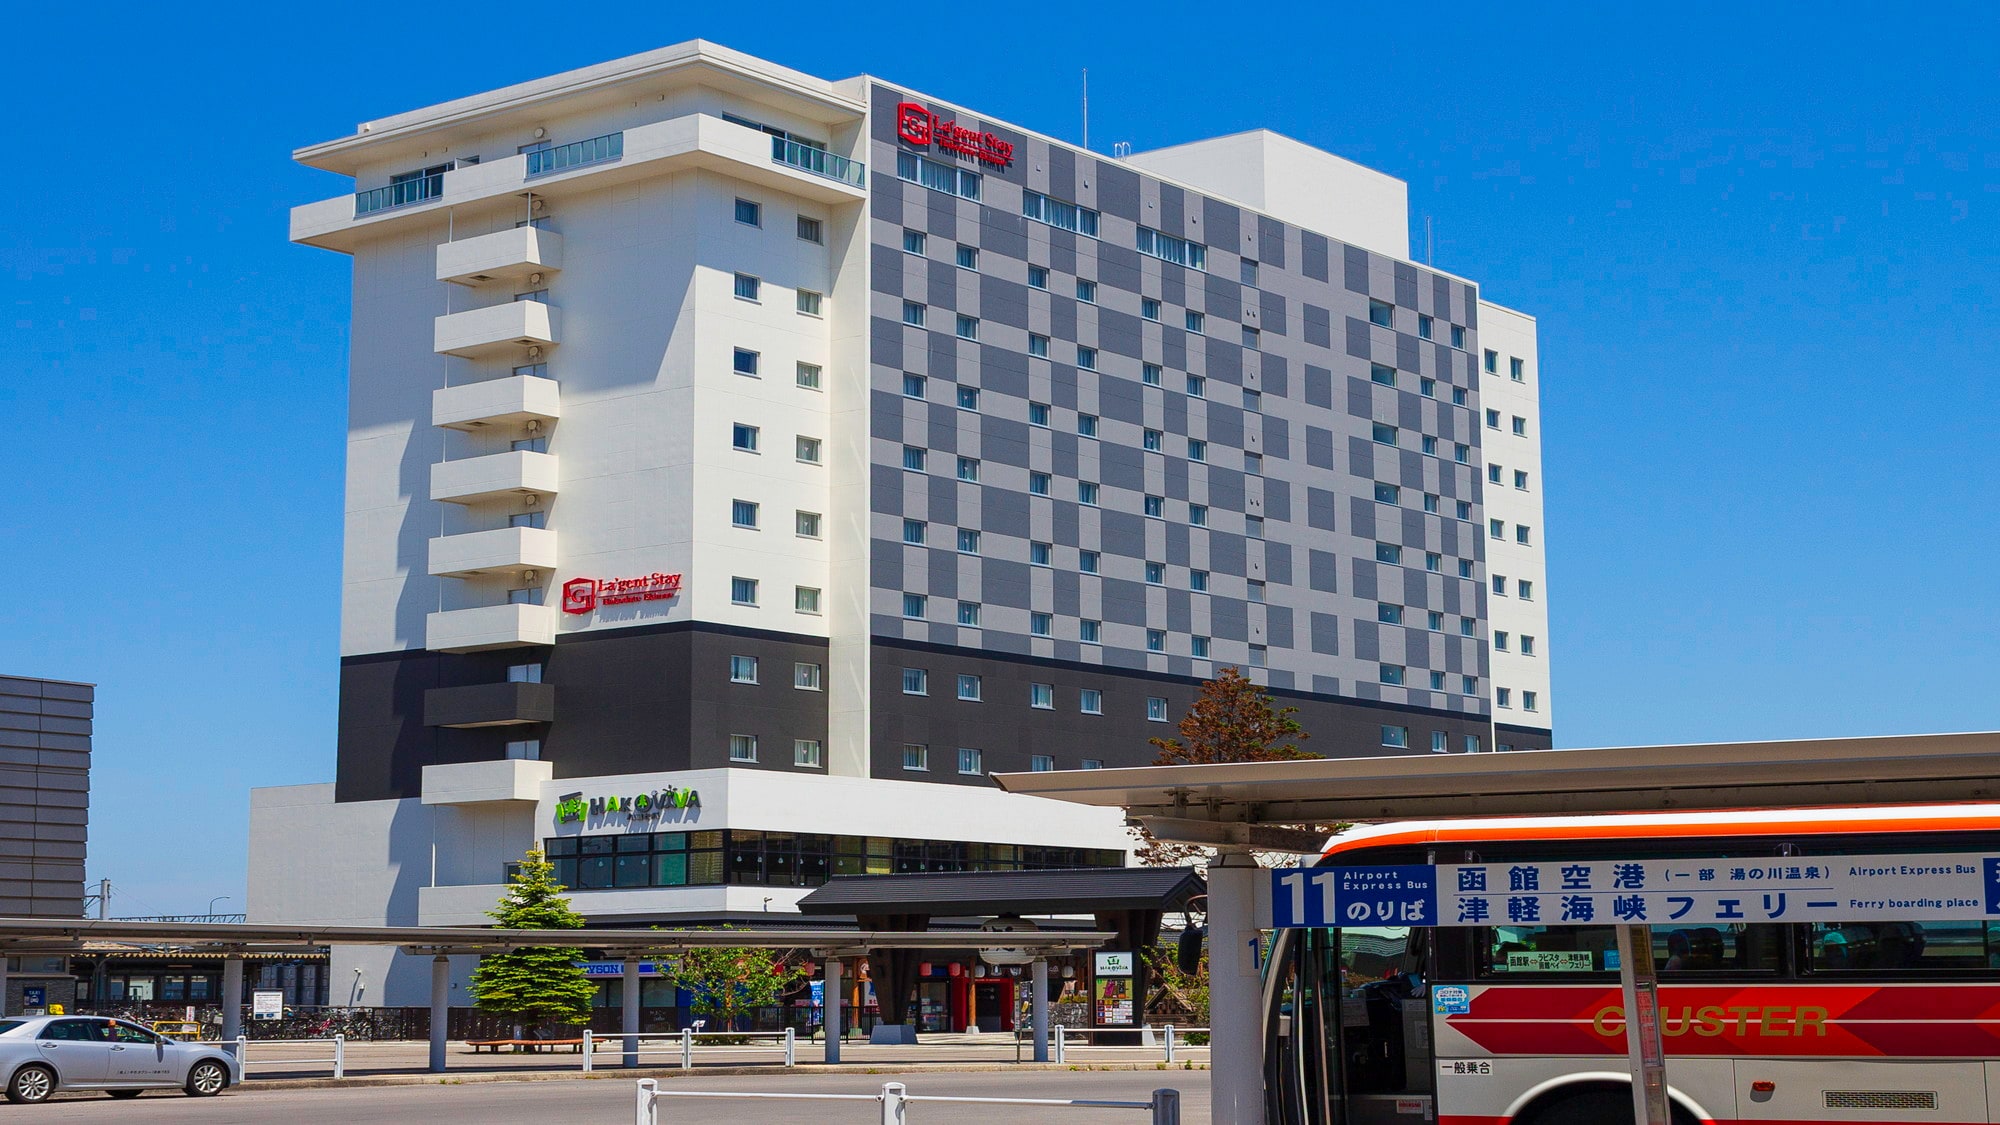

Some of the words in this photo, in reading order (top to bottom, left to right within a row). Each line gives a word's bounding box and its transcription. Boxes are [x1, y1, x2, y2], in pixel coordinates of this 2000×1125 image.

[934, 115, 983, 144] La'gent
[985, 132, 1014, 157] Stay
[598, 575, 649, 592] La'gent
[651, 572, 682, 588] Stay
[1343, 871, 1398, 881] Airport
[1849, 866, 1897, 877] Airport
[1900, 865, 1952, 876] Express
[1955, 864, 1976, 874] Bus
[1457, 864, 1646, 892] 函館空港
[1343, 881, 1402, 891] Express
[1407, 880, 1428, 889] Bus
[1280, 871, 1336, 925] 11
[1850, 899, 1885, 909] Ferry
[1888, 898, 1943, 909] boarding
[1946, 898, 1979, 908] place
[1346, 899, 1425, 921] のりば
[1457, 894, 1838, 923] 津軽海峡フェリー
[1509, 956, 1530, 967] 函館駅
[1538, 953, 1560, 961] ラビスタ
[1569, 961, 1591, 969] フェリー
[1593, 1005, 1829, 1037] CUSTER
[1441, 1061, 1491, 1075] 一般乗合
